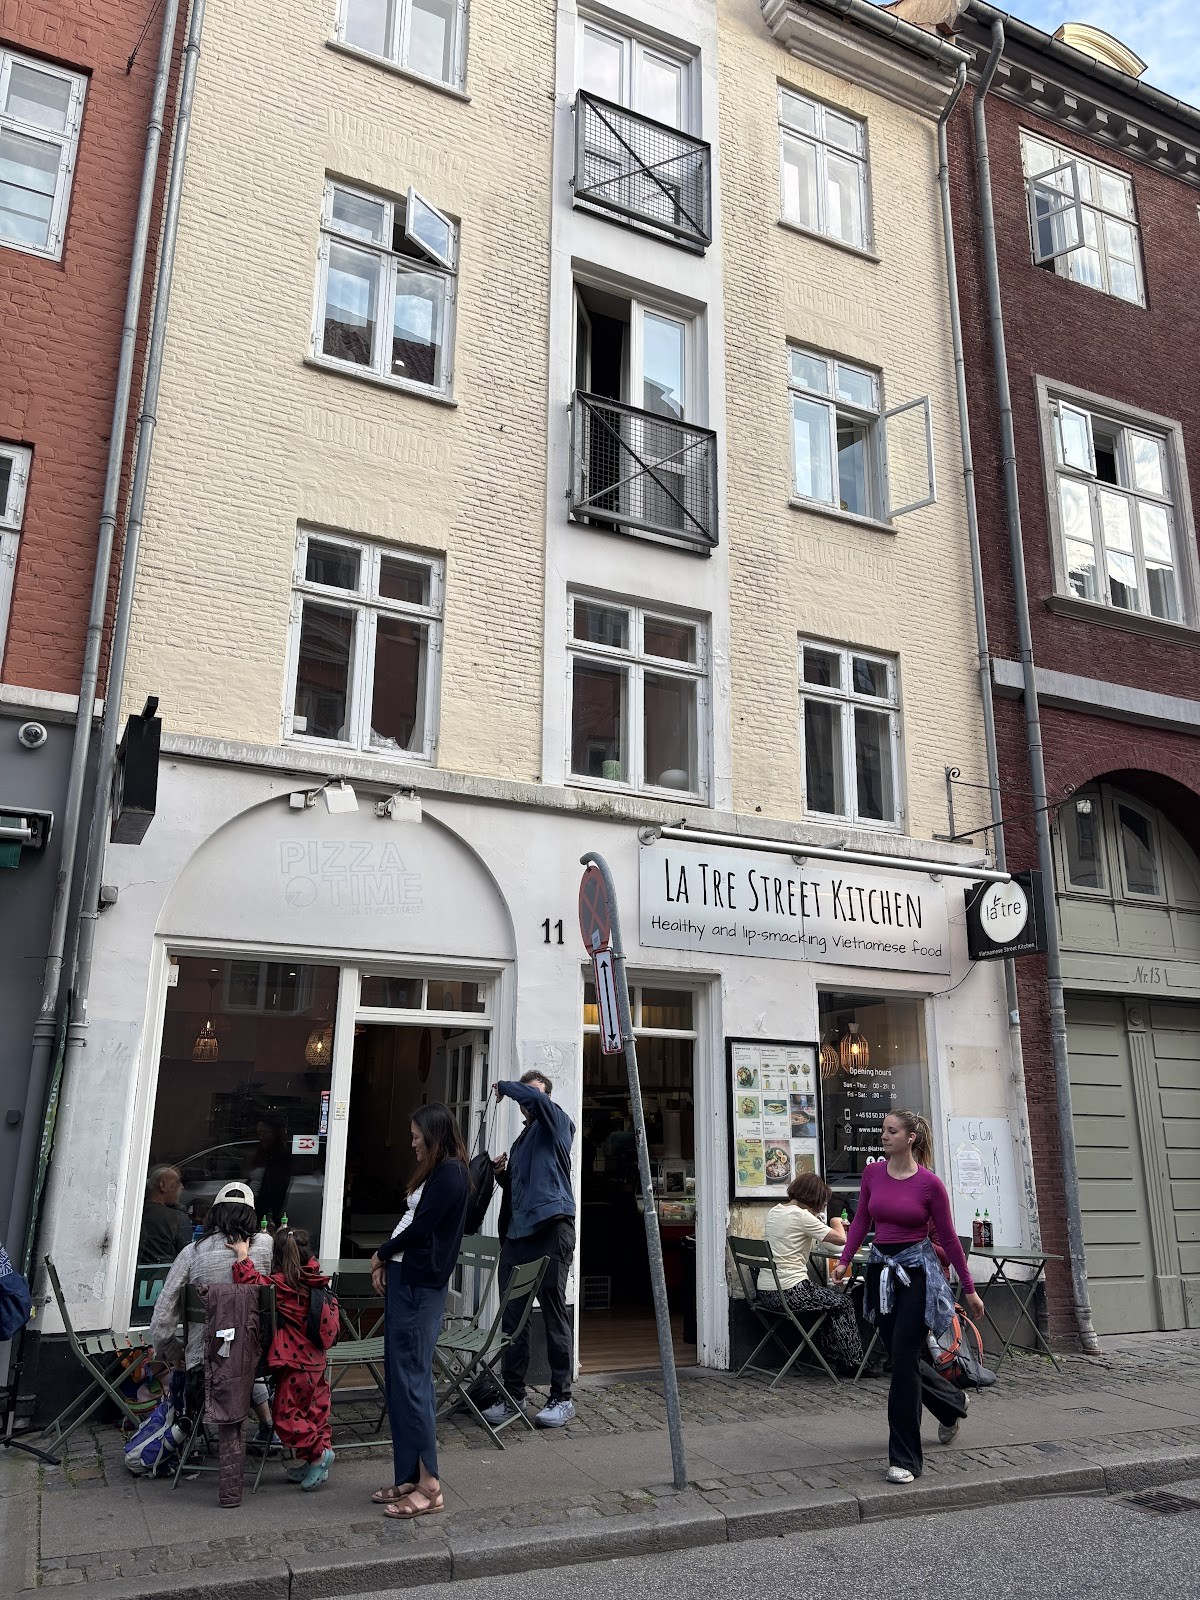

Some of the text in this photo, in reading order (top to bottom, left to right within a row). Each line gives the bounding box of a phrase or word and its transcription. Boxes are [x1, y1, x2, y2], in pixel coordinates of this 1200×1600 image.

[279, 840, 407, 875] PIZZA
[321, 873, 423, 907] TIME
[665, 858, 923, 929] LA TRE STREET KITCHEN
[541, 917, 565, 945] 11
[651, 915, 943, 958] Healthy and lip-smacking Vietnamese food
[978, 942, 1035, 957] Vietnamese Street Kitchen
[849, 1066, 892, 1077] Opening hours
[843, 1144, 860, 1152] Follow
